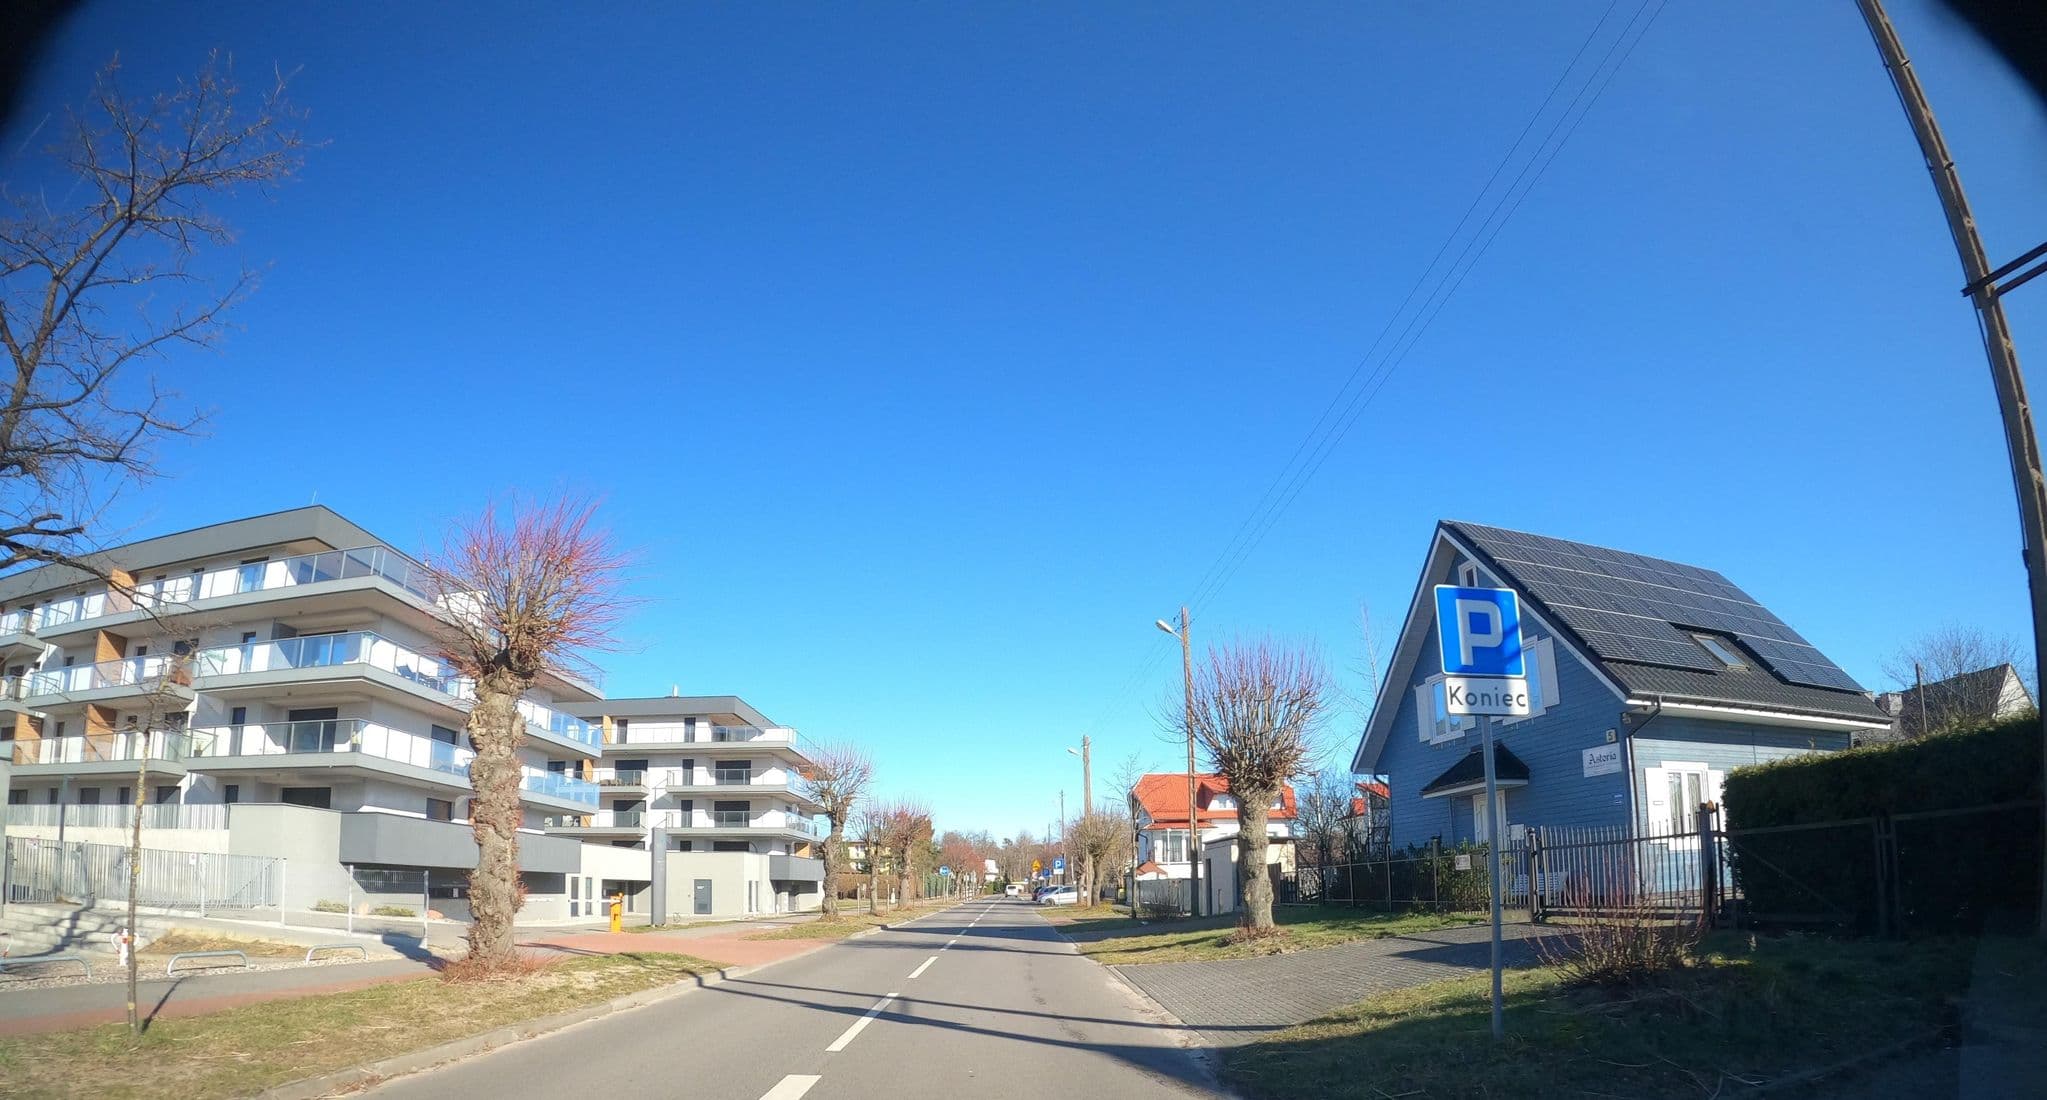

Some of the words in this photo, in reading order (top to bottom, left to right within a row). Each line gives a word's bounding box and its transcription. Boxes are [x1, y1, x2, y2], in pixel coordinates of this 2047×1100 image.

[1456, 598, 1503, 666] P
[1448, 686, 1526, 707] Koniec
[1588, 753, 1617, 765] Astoria
